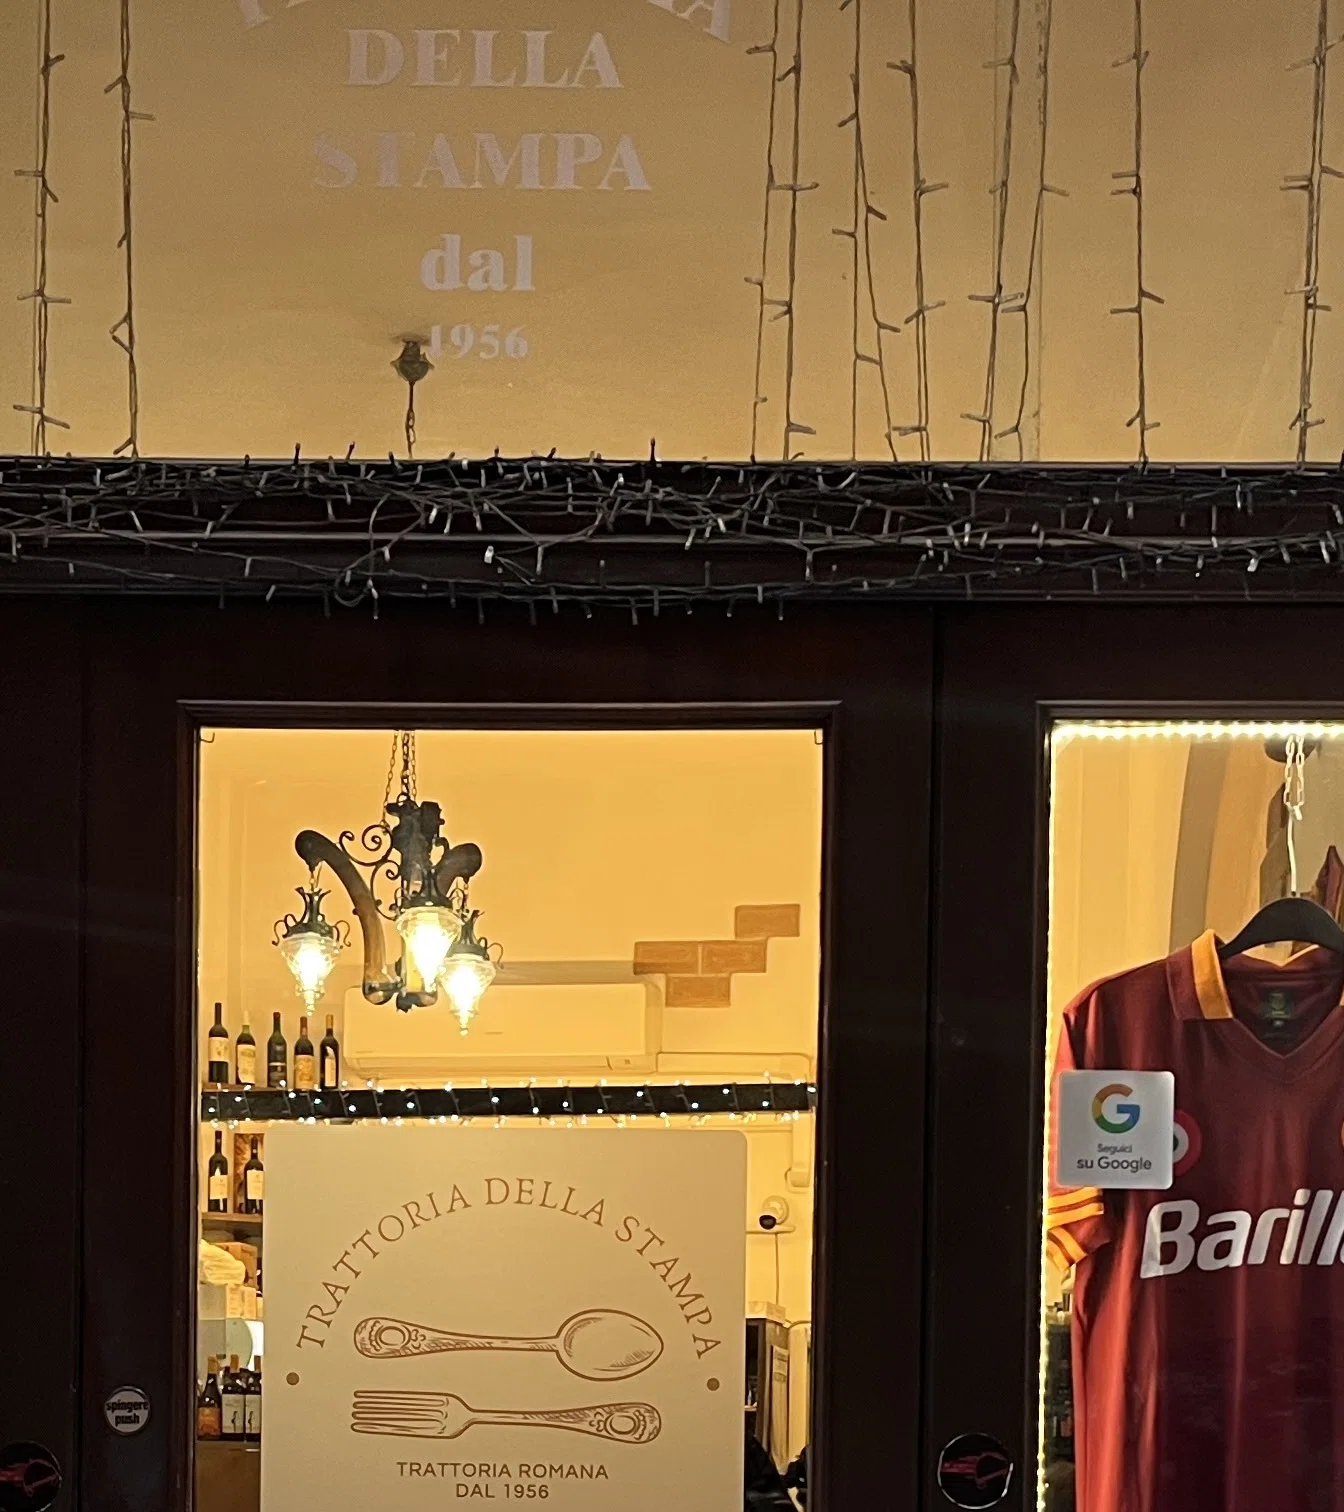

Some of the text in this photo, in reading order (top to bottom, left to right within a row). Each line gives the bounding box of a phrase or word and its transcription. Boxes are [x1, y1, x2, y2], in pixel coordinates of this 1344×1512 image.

[344, 27, 624, 89] DELLA
[311, 130, 653, 191] STAMPA
[419, 233, 536, 292] dal
[427, 322, 530, 361] 1956
[1096, 1143, 1133, 1155] Seguici
[1076, 1156, 1152, 1173] su Google
[296, 1177, 722, 1360] TRATTORIA DELLA STAMPA
[105, 1398, 149, 1413] spingere
[114, 1412, 140, 1427] push
[396, 1460, 609, 1480] TRATTORIA ROMANA
[455, 1482, 550, 1500] DAL 1956
